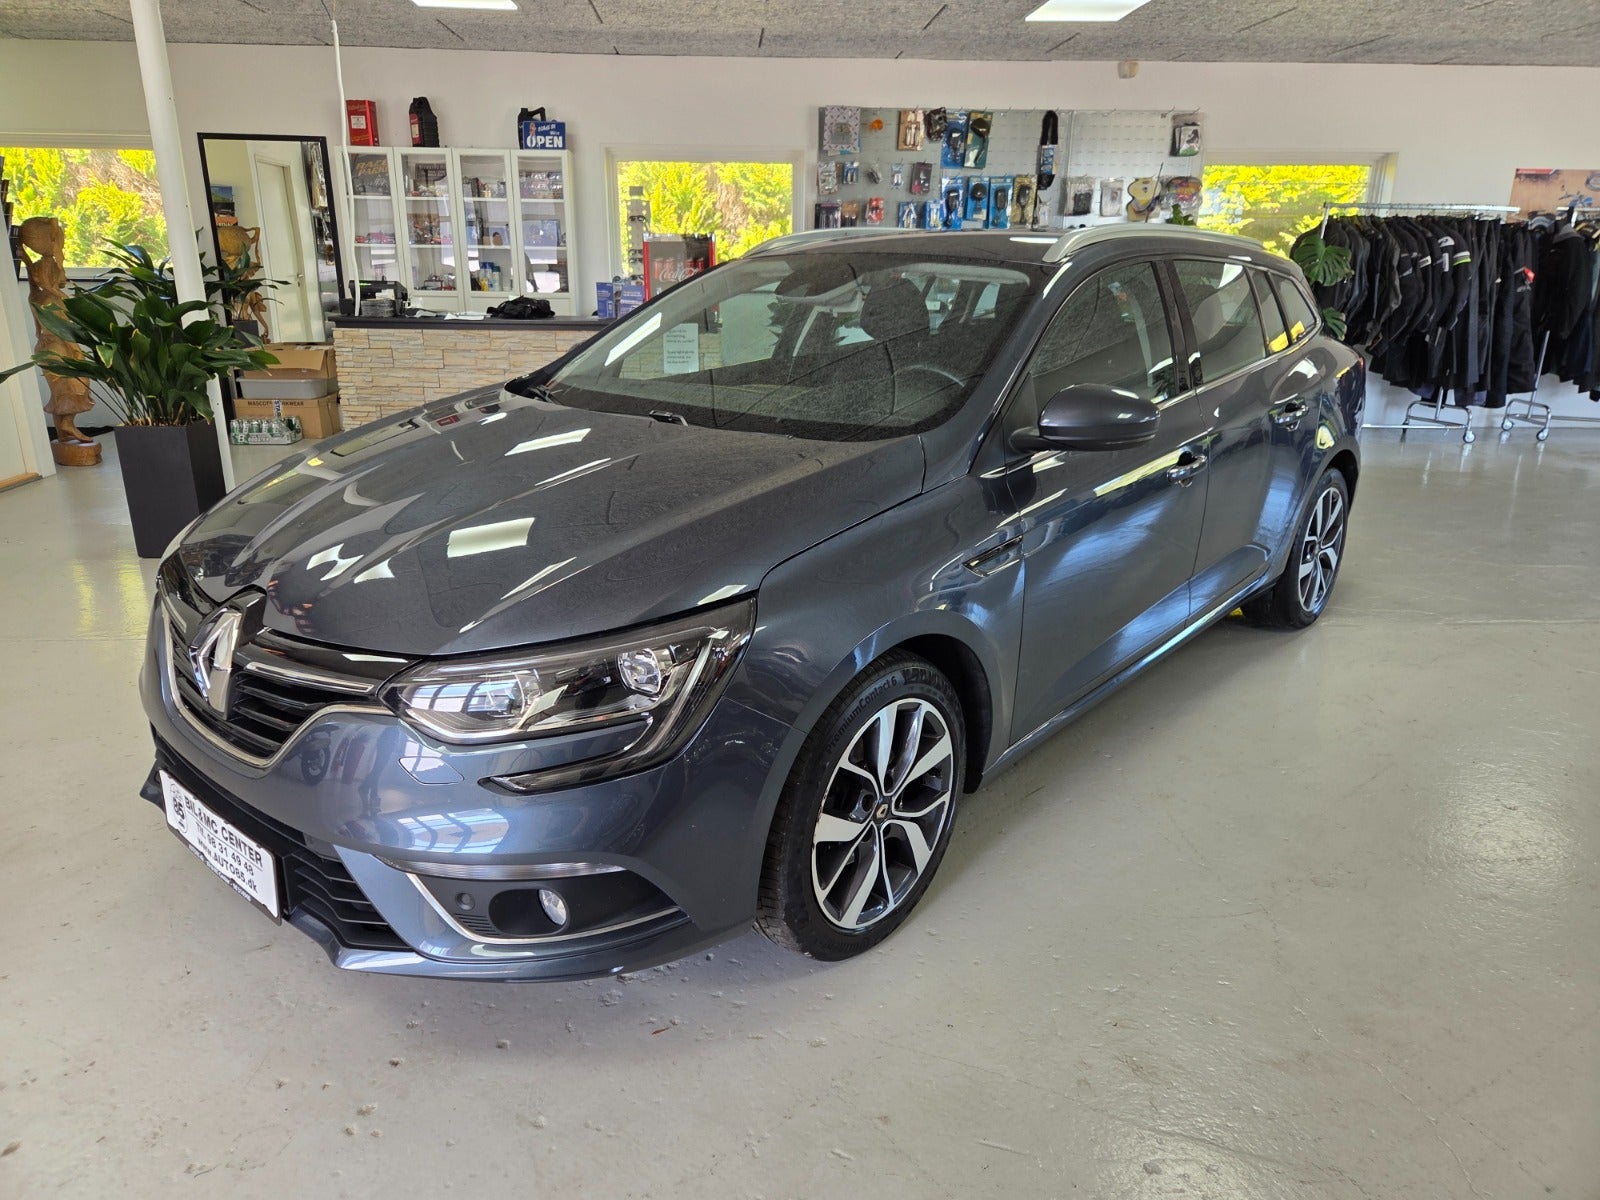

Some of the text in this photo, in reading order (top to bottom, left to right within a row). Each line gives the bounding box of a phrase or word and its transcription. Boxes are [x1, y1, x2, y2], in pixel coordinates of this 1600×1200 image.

[526, 135, 563, 148] OPEN
[825, 680, 892, 753] PremiumContact
[891, 675, 898, 687] 6
[183, 795, 218, 834] BIL&MC
[221, 827, 263, 867] CENTER
[218, 842, 229, 858] 31
[231, 852, 242, 866] 49
[243, 863, 255, 876] 48
